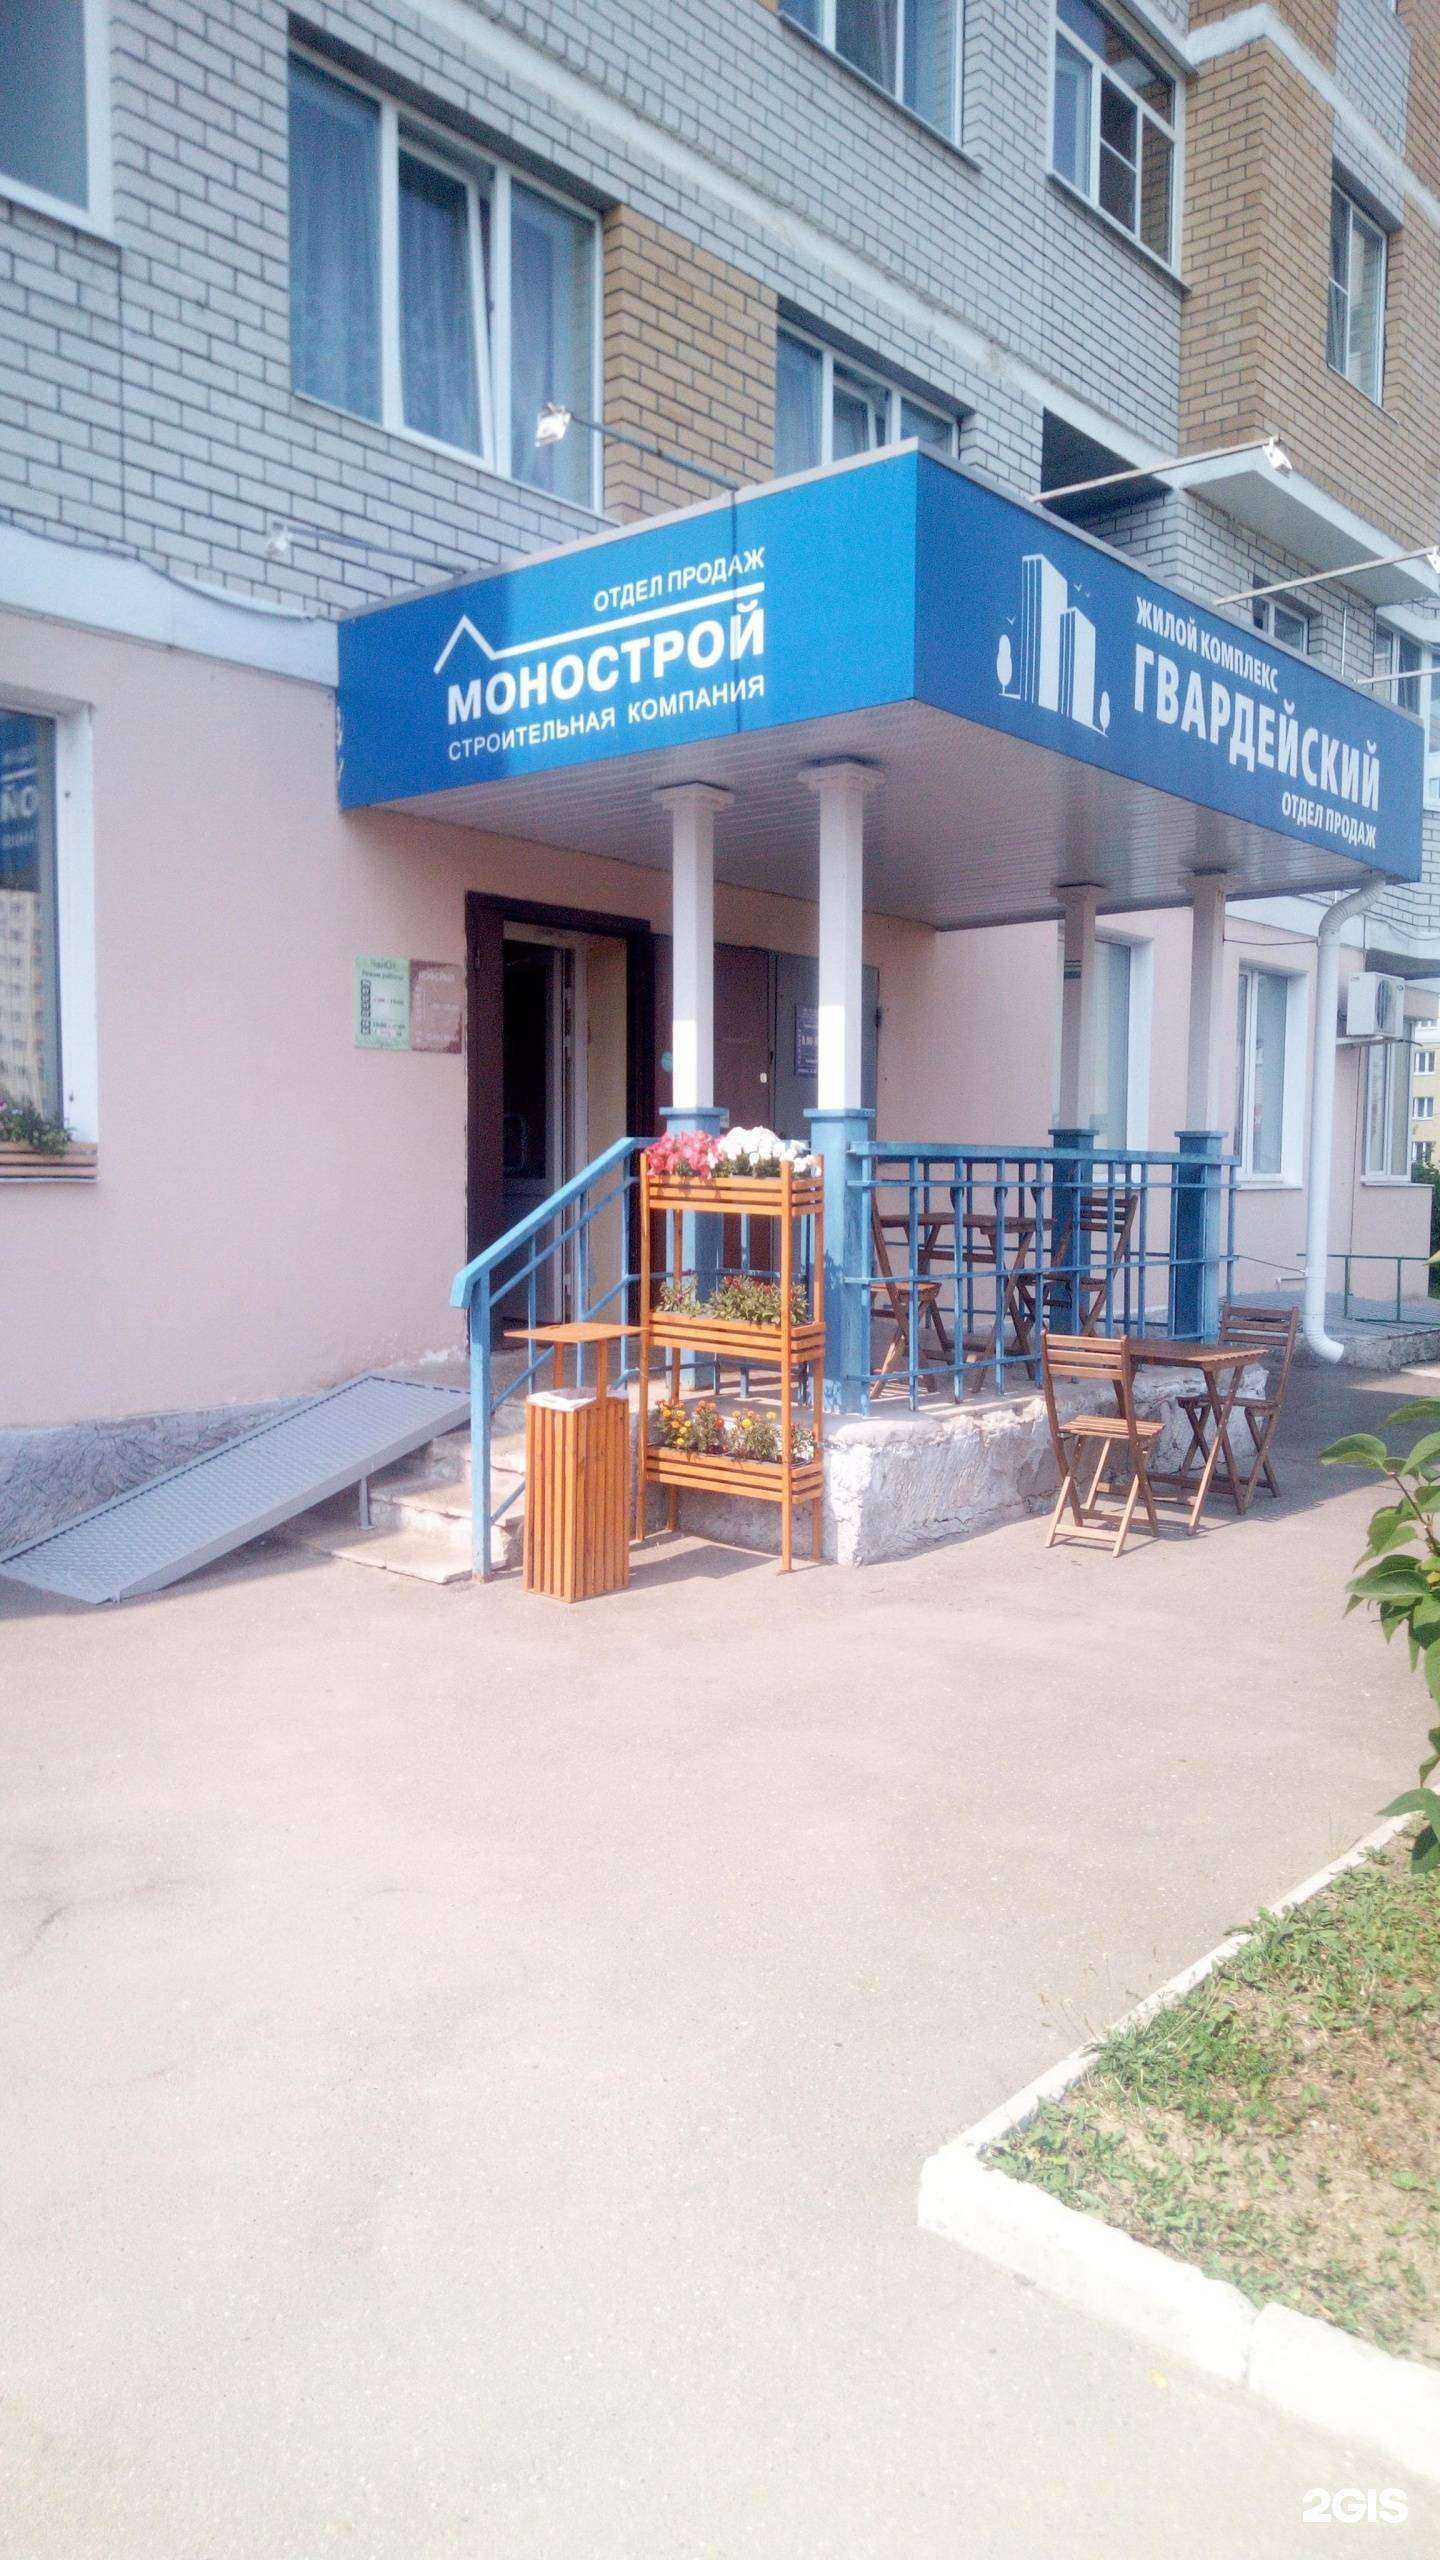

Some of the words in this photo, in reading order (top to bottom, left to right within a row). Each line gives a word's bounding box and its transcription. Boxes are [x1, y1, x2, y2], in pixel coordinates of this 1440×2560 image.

[593, 575, 663, 613] ОТДЕЛ
[667, 547, 765, 592] ПРОДАЖ
[447, 598, 765, 726] МОНОСТРОЙ
[1136, 595, 1198, 653] ЖИЛОЙ
[1201, 630, 1279, 694] КОМПЛЕКС
[449, 707, 616, 761] СТРОИТЕЛЬНАЯ
[628, 674, 765, 724] КОМПАНИЯ
[1134, 643, 1380, 812] ГВАРДЕЙСКИЙ
[1281, 791, 1323, 829] ОТДЕЛ
[1326, 808, 1376, 849] ПРОДАЖ
